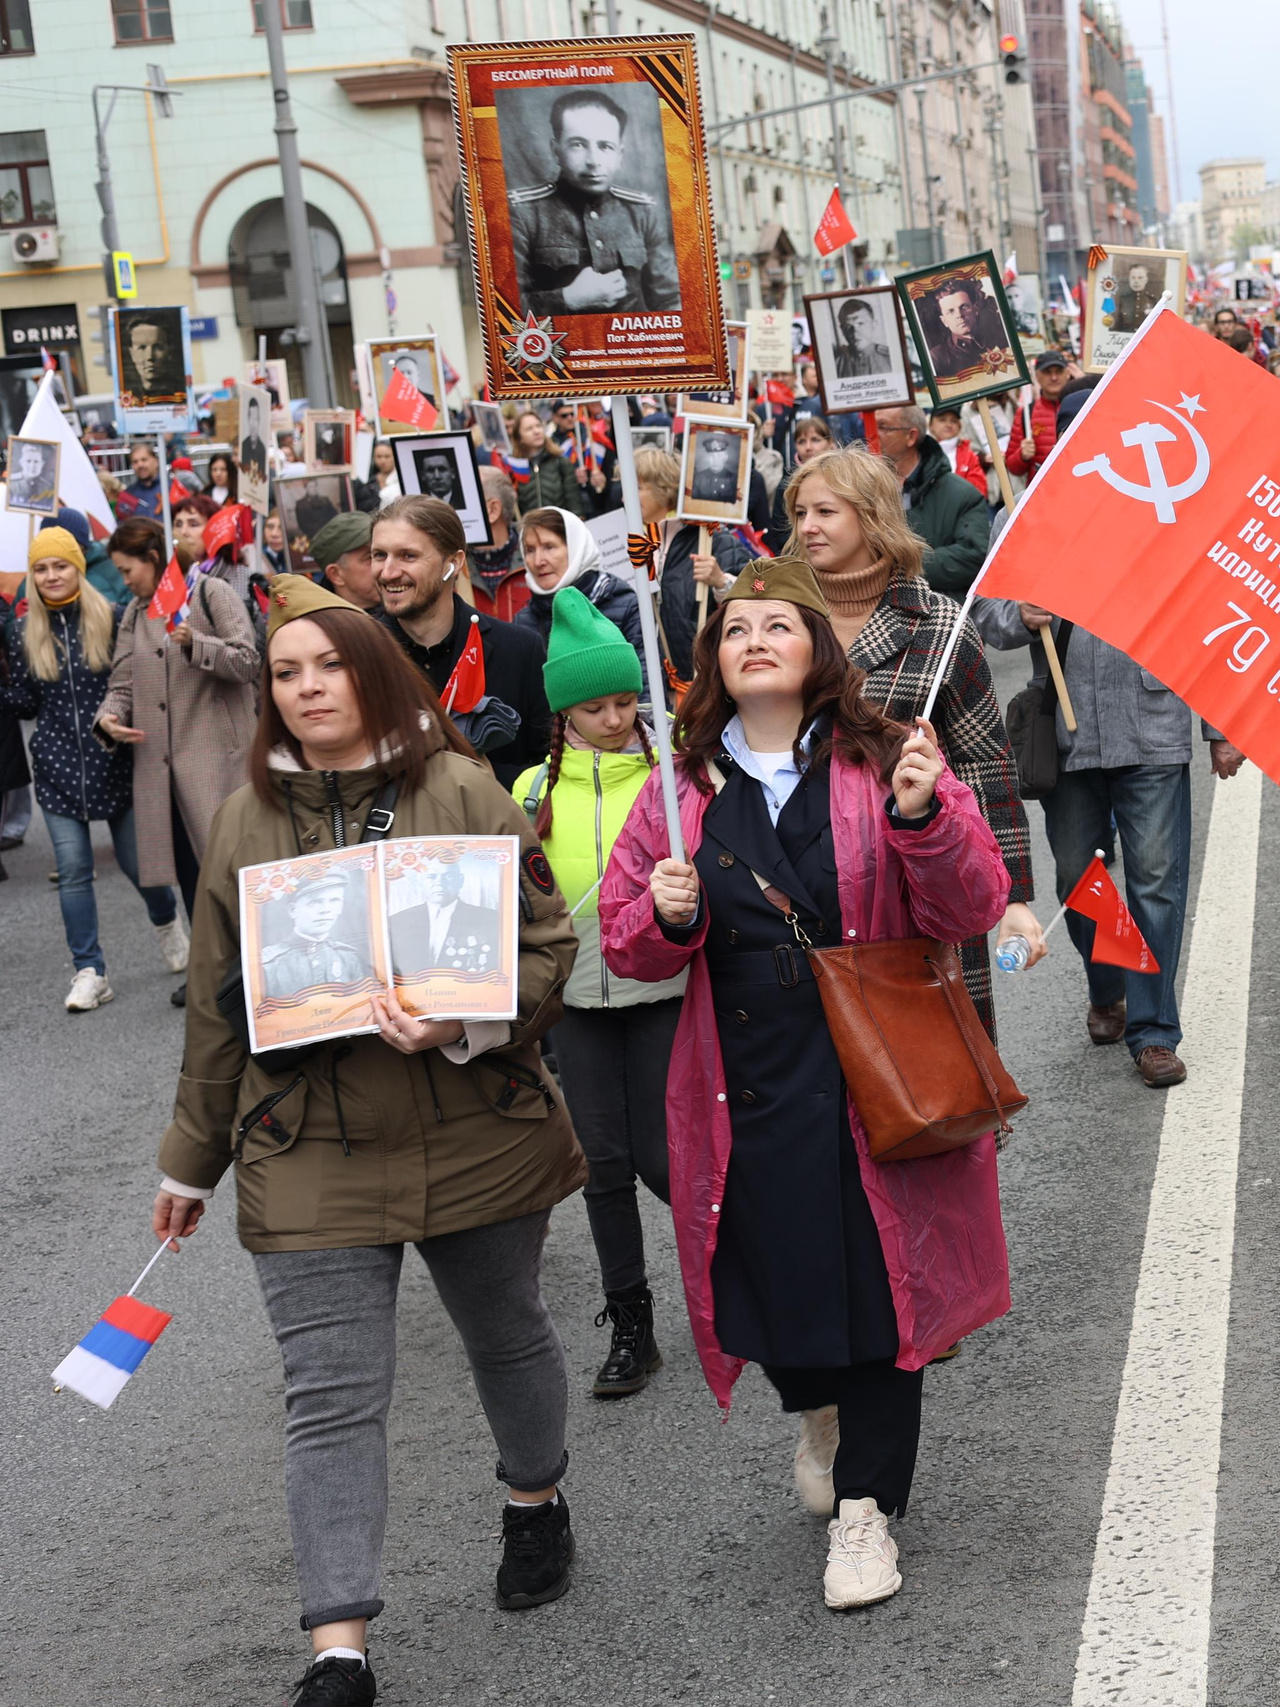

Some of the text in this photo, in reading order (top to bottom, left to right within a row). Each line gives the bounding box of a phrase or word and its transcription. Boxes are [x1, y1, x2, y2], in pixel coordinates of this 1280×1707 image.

[491, 65, 614, 82] БЕССМЕРТНЫЙ ПОЛК
[611, 315, 682, 331] АЛАКАЕВ
[12, 324, 78, 344] DRINX
[607, 333, 625, 343] Пот
[840, 378, 887, 391] Андрюков
[1202, 600, 1271, 674] 79
